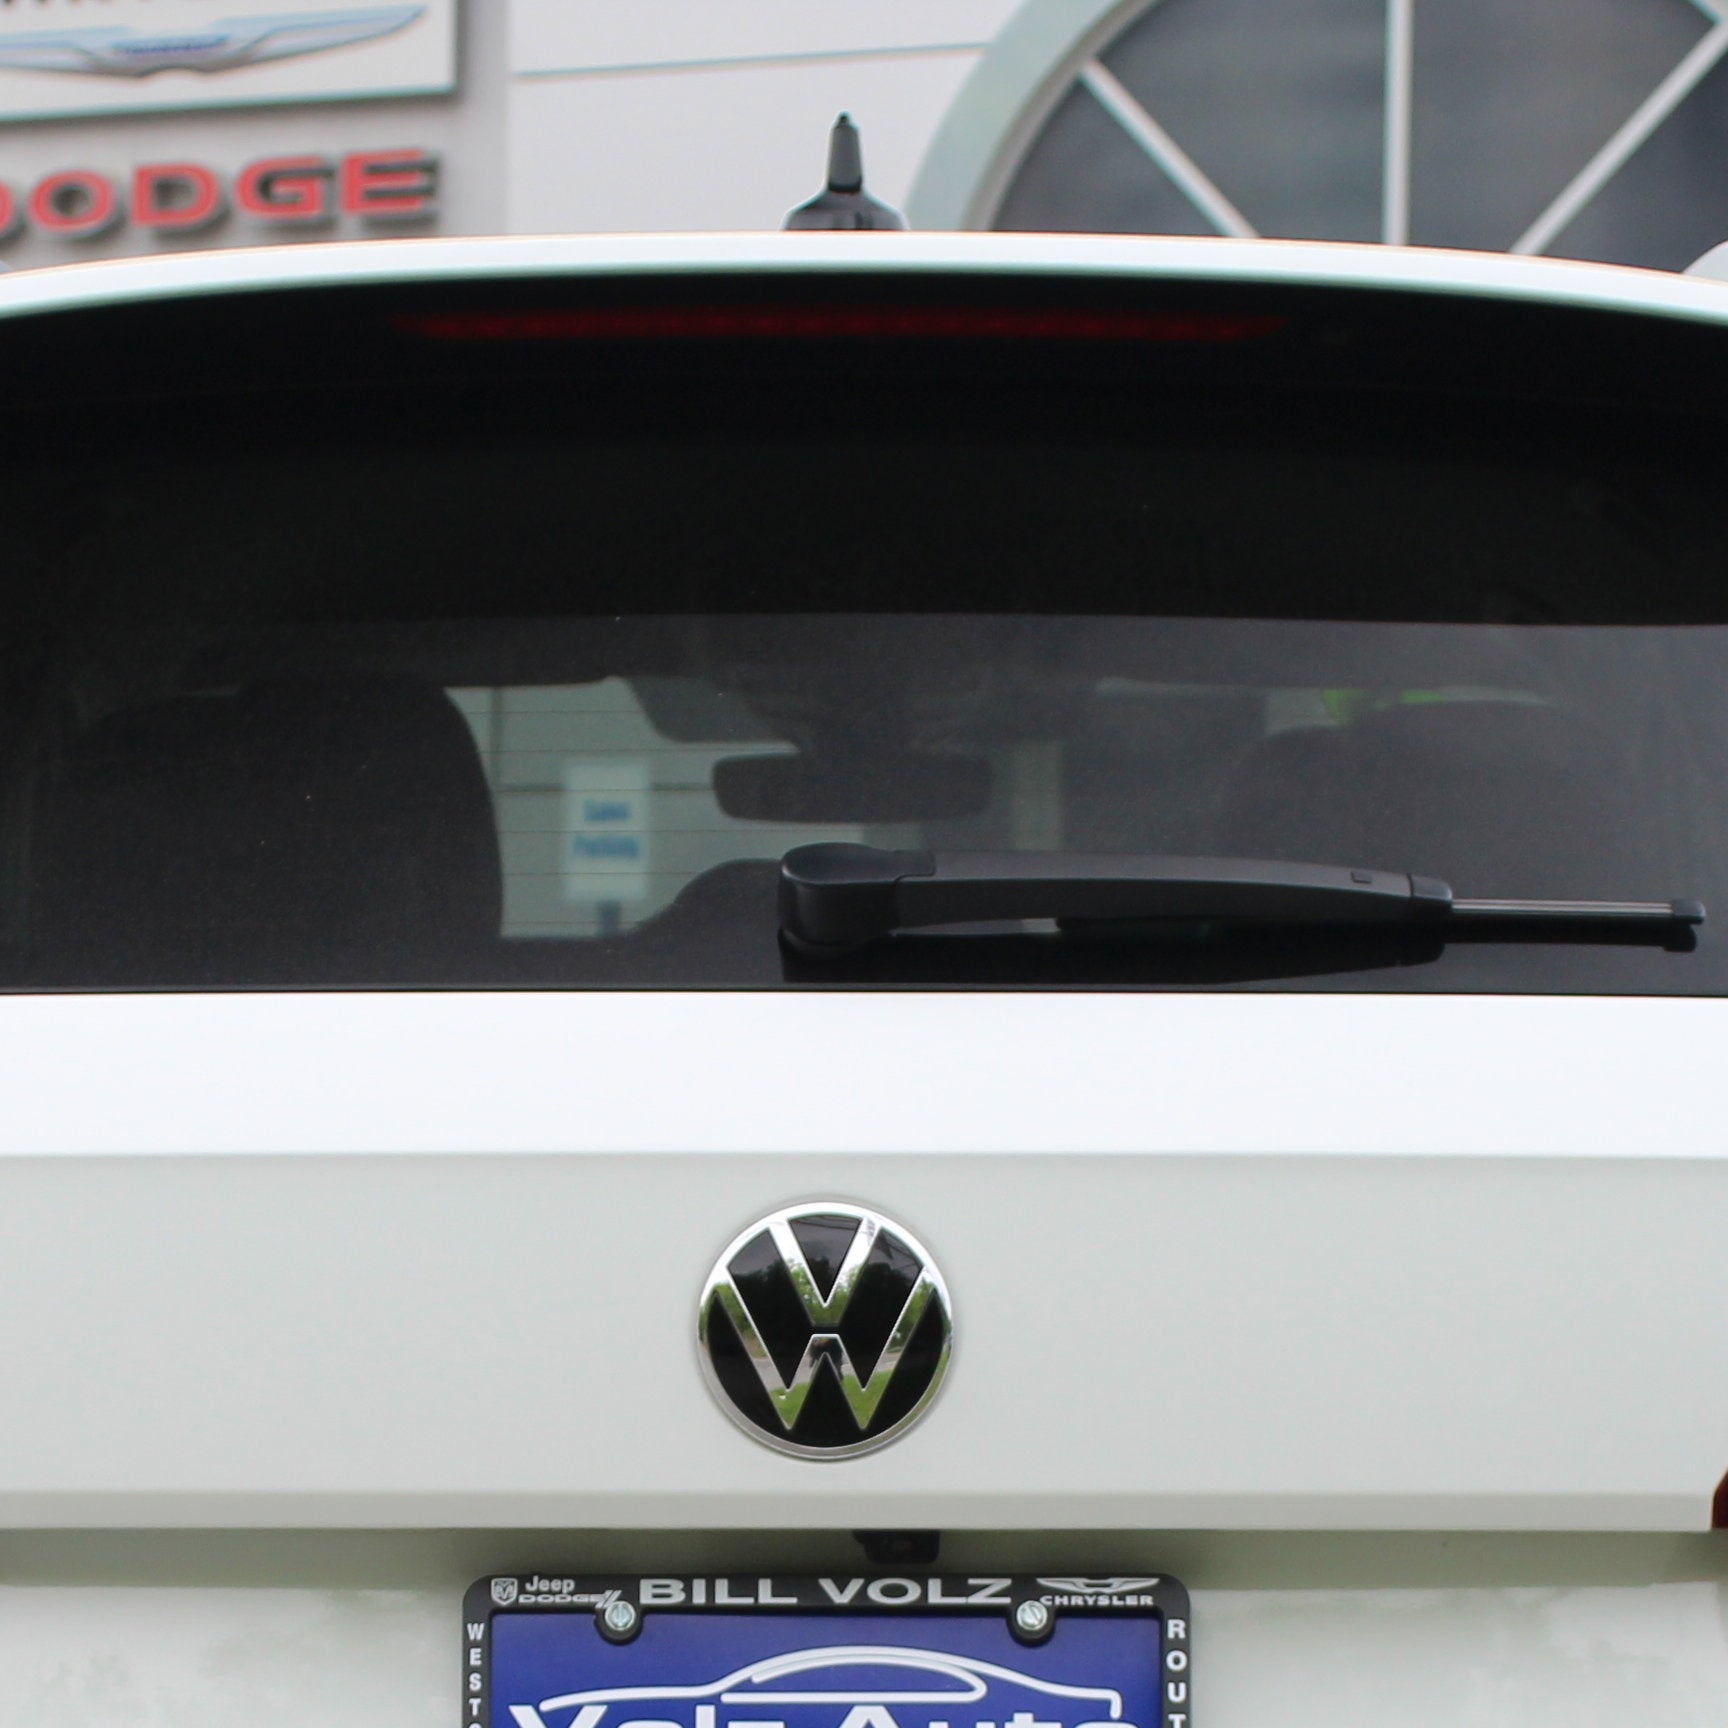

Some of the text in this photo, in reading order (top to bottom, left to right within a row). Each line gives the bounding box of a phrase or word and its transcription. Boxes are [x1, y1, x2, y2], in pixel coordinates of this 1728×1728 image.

[525, 1575, 575, 1594] Jeep
[640, 1578, 1012, 1604] BILL VOLZ
[1040, 1595, 1154, 1607] CHRYSLER
